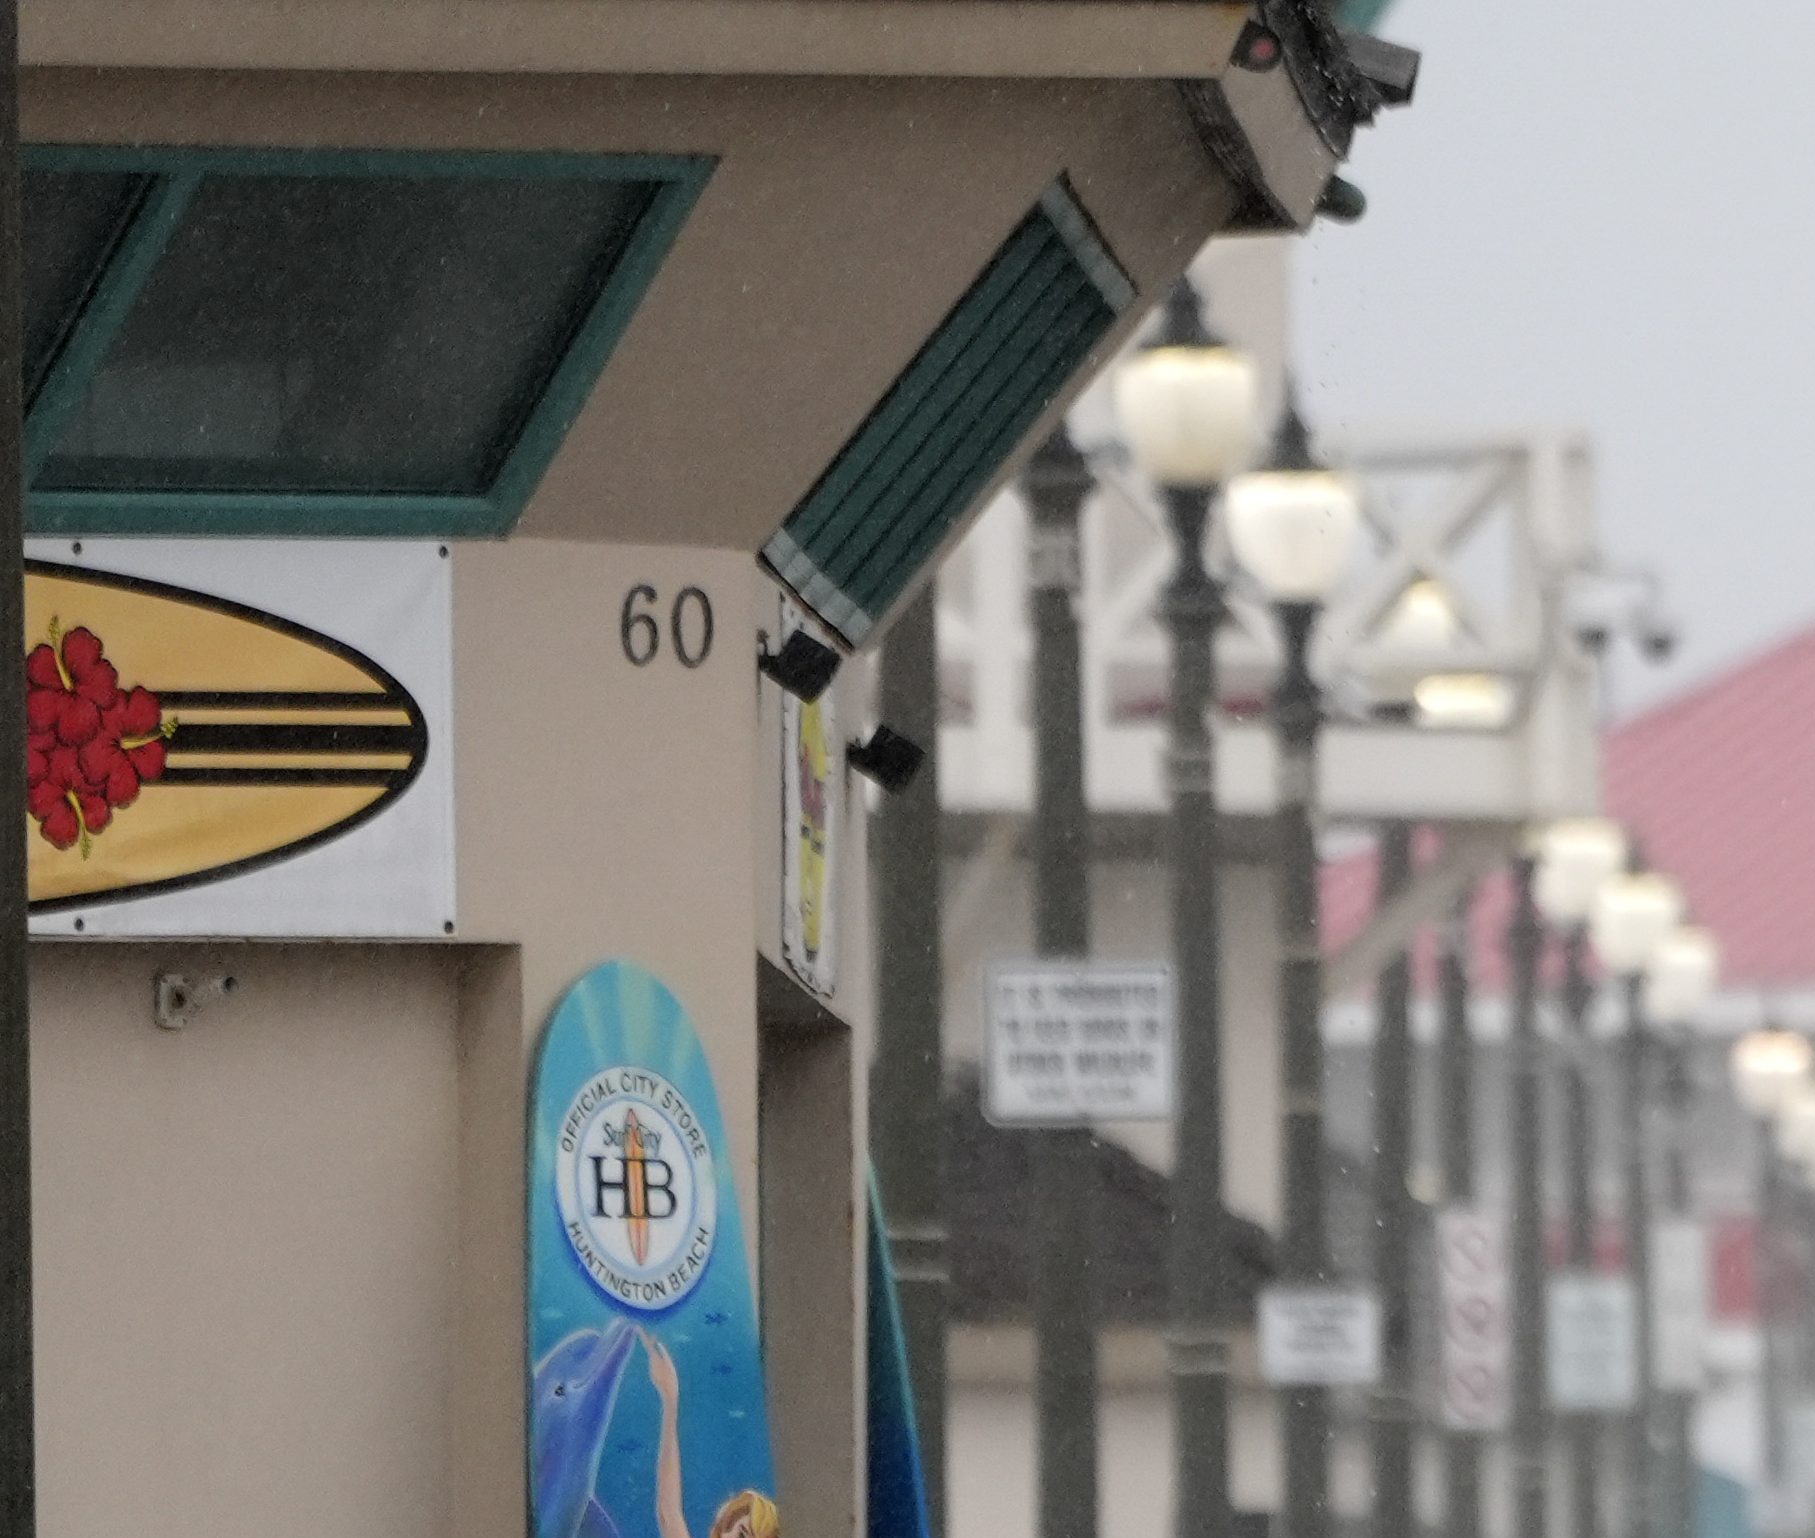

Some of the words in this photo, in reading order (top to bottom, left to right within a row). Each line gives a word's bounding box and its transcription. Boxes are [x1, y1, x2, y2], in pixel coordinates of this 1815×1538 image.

[621, 584, 715, 669] 60
[562, 1078, 617, 1153] OFFICIAL
[620, 1072, 660, 1098] CITY
[661, 1090, 707, 1160] STORE
[587, 1155, 677, 1220] HB
[568, 1221, 667, 1300] HUNTINGTON
[667, 1226, 710, 1292] BEACH
